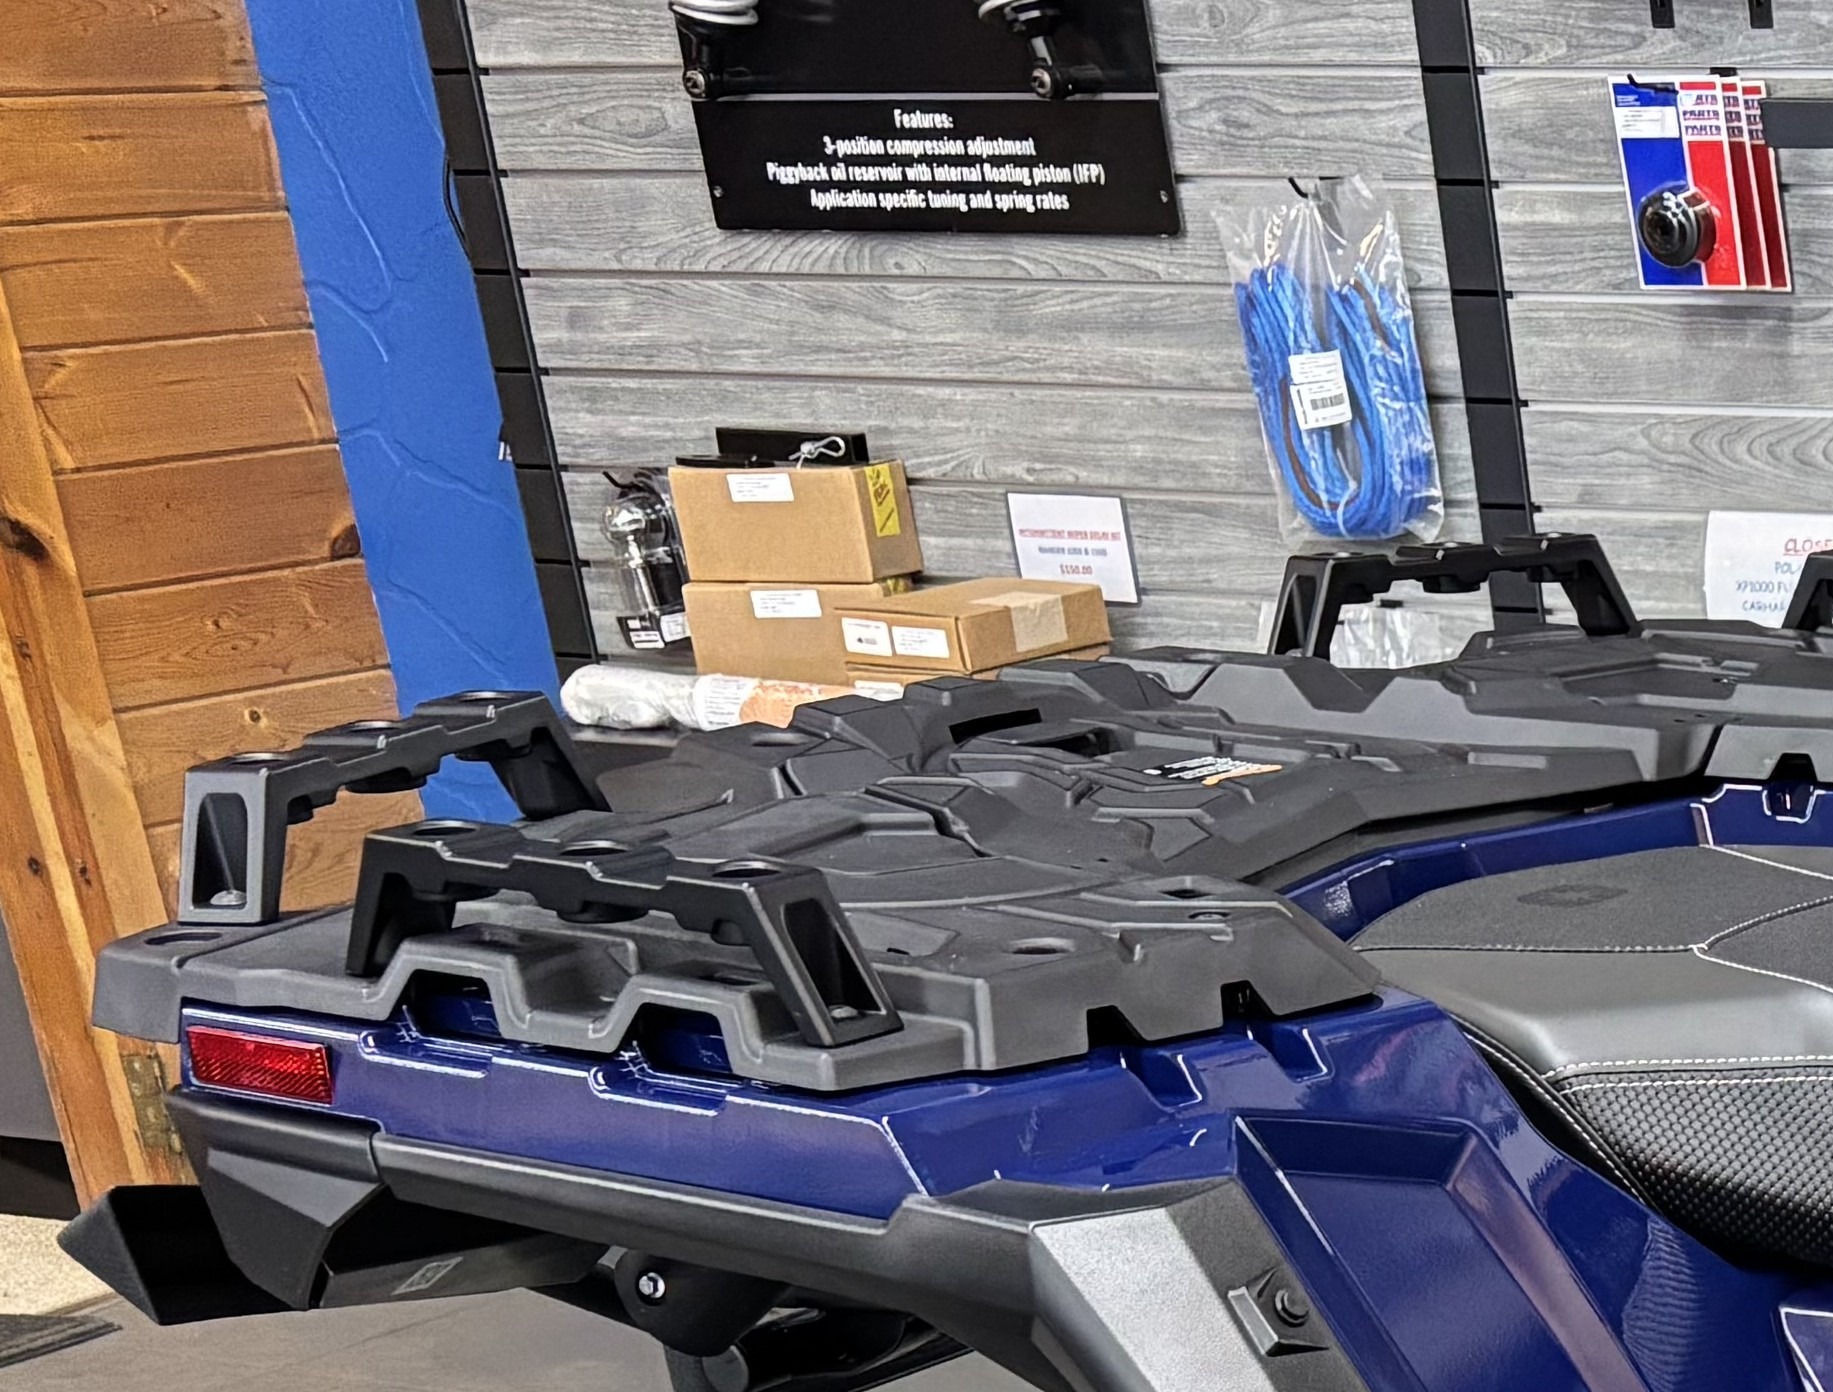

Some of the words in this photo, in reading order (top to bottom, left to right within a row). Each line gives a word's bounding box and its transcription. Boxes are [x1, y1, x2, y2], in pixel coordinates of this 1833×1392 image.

[893, 108, 954, 129] Features:
[823, 136, 884, 159] 3-position
[886, 138, 965, 157] compression
[966, 136, 1037, 158] adjustment
[766, 161, 829, 185] Piggyback
[831, 162, 847, 182] oil
[848, 163, 903, 183] reservoir
[904, 163, 932, 182] with
[933, 163, 982, 183] internal
[983, 163, 1032, 186] floating
[1033, 164, 1072, 185] piston
[1073, 163, 1107, 186] (IFP)
[809, 188, 878, 210] Application
[879, 189, 927, 211] specific
[928, 189, 968, 212] tuning
[969, 190, 994, 210] and
[995, 190, 1035, 213] spring
[1036, 191, 1071, 211] rates
